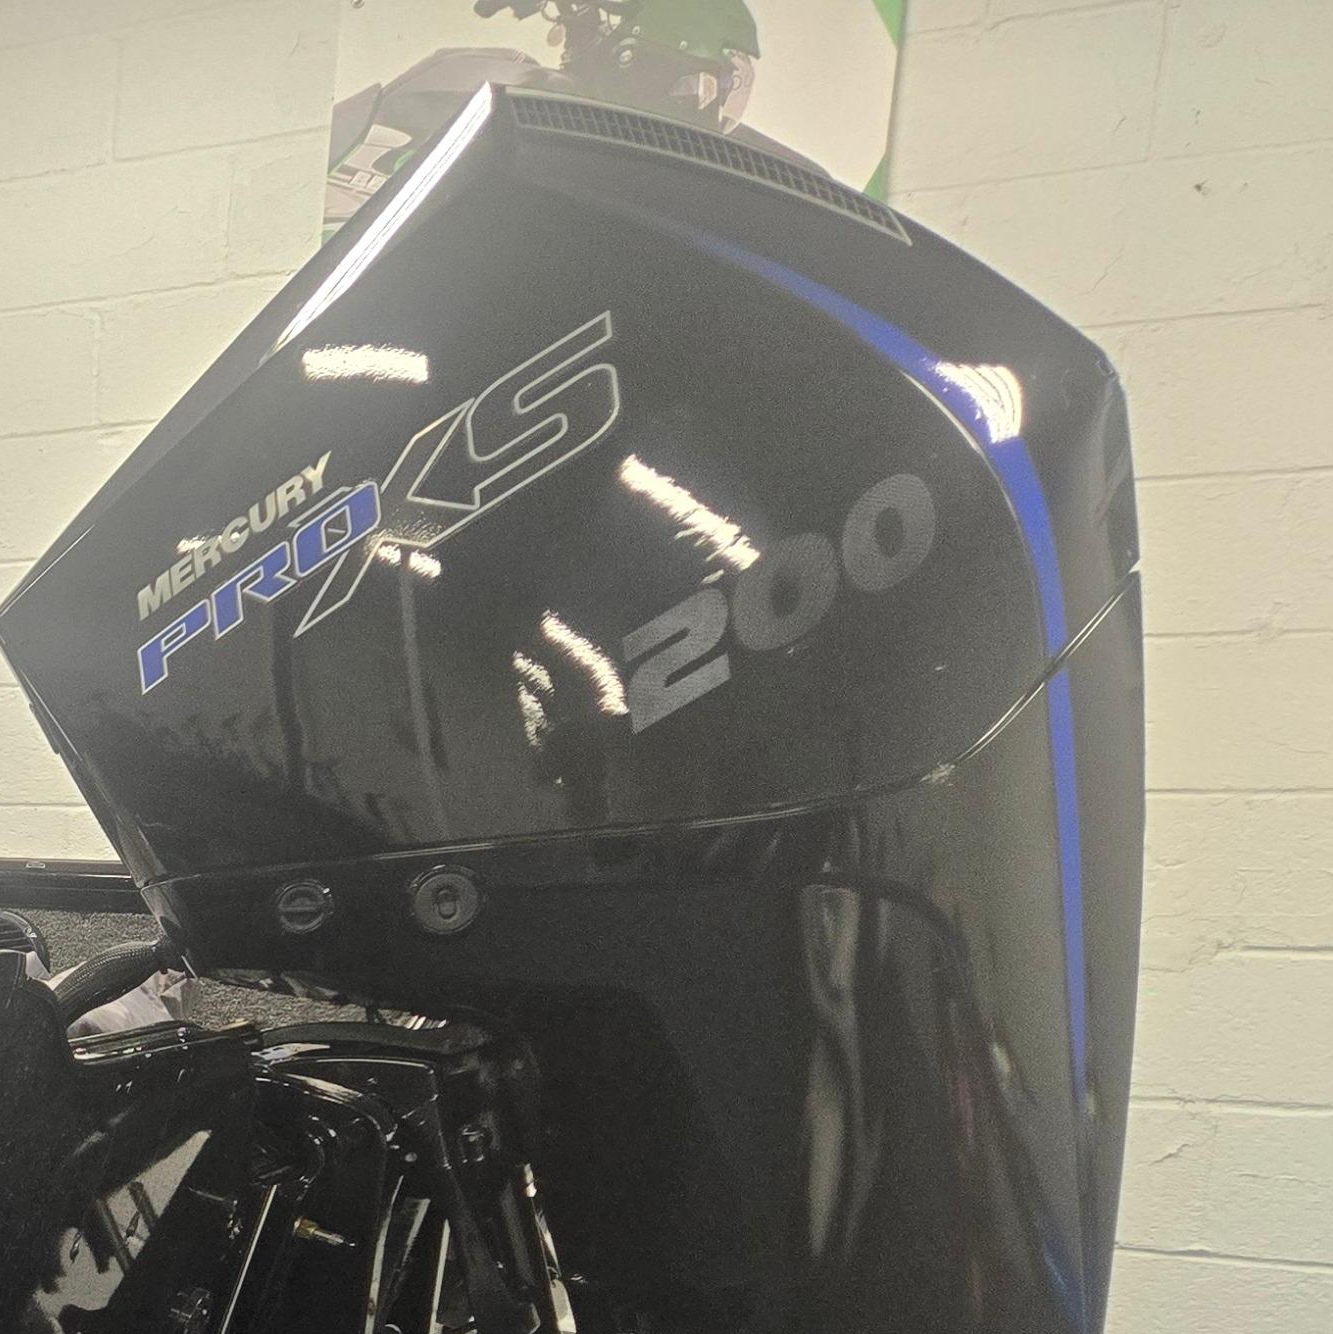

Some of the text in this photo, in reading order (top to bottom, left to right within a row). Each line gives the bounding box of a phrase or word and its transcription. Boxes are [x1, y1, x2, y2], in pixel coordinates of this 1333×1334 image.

[136, 450, 332, 621] MERCURY
[137, 310, 620, 695] PRO XS
[624, 473, 934, 734] 200
